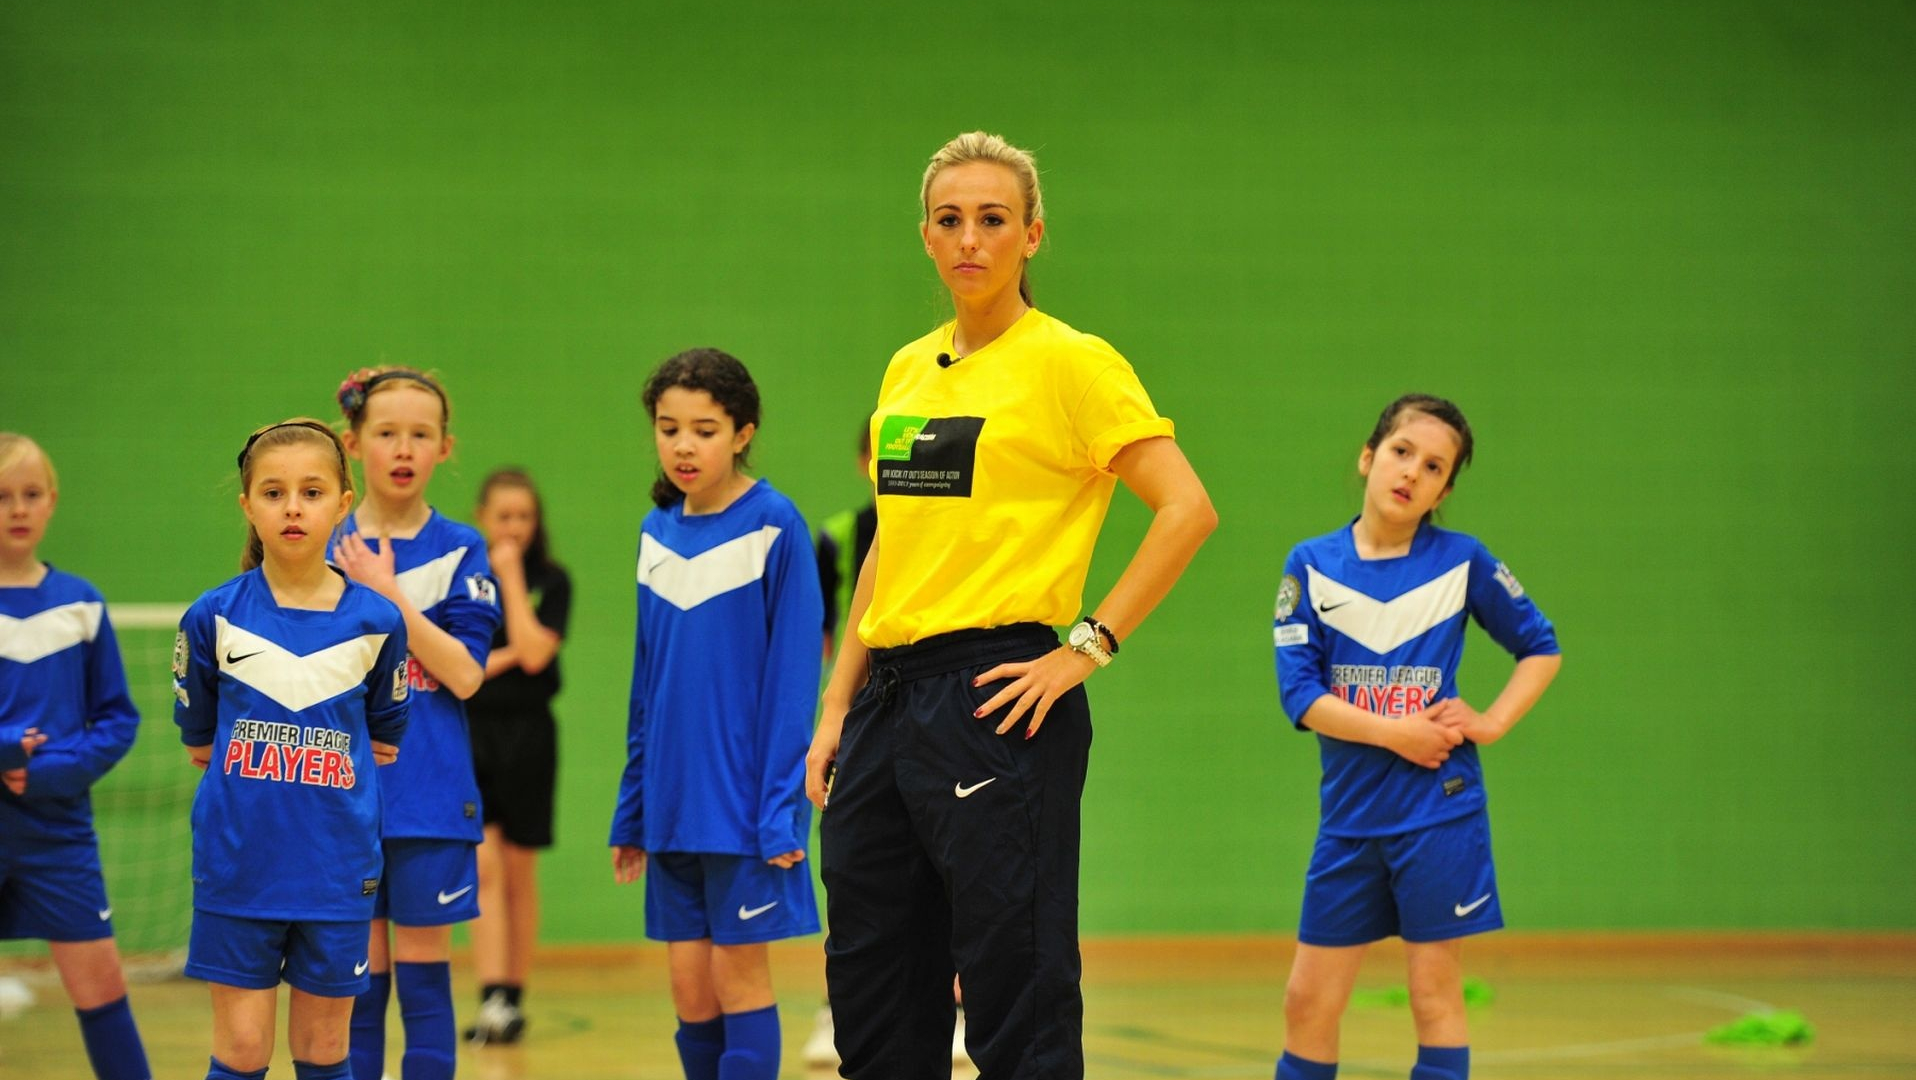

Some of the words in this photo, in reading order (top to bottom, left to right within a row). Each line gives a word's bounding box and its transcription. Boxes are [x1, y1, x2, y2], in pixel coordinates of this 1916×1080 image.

[1389, 665, 1442, 688] LEAGUE
[231, 719, 301, 746] PREMIER
[224, 739, 356, 790] PLAYERS
